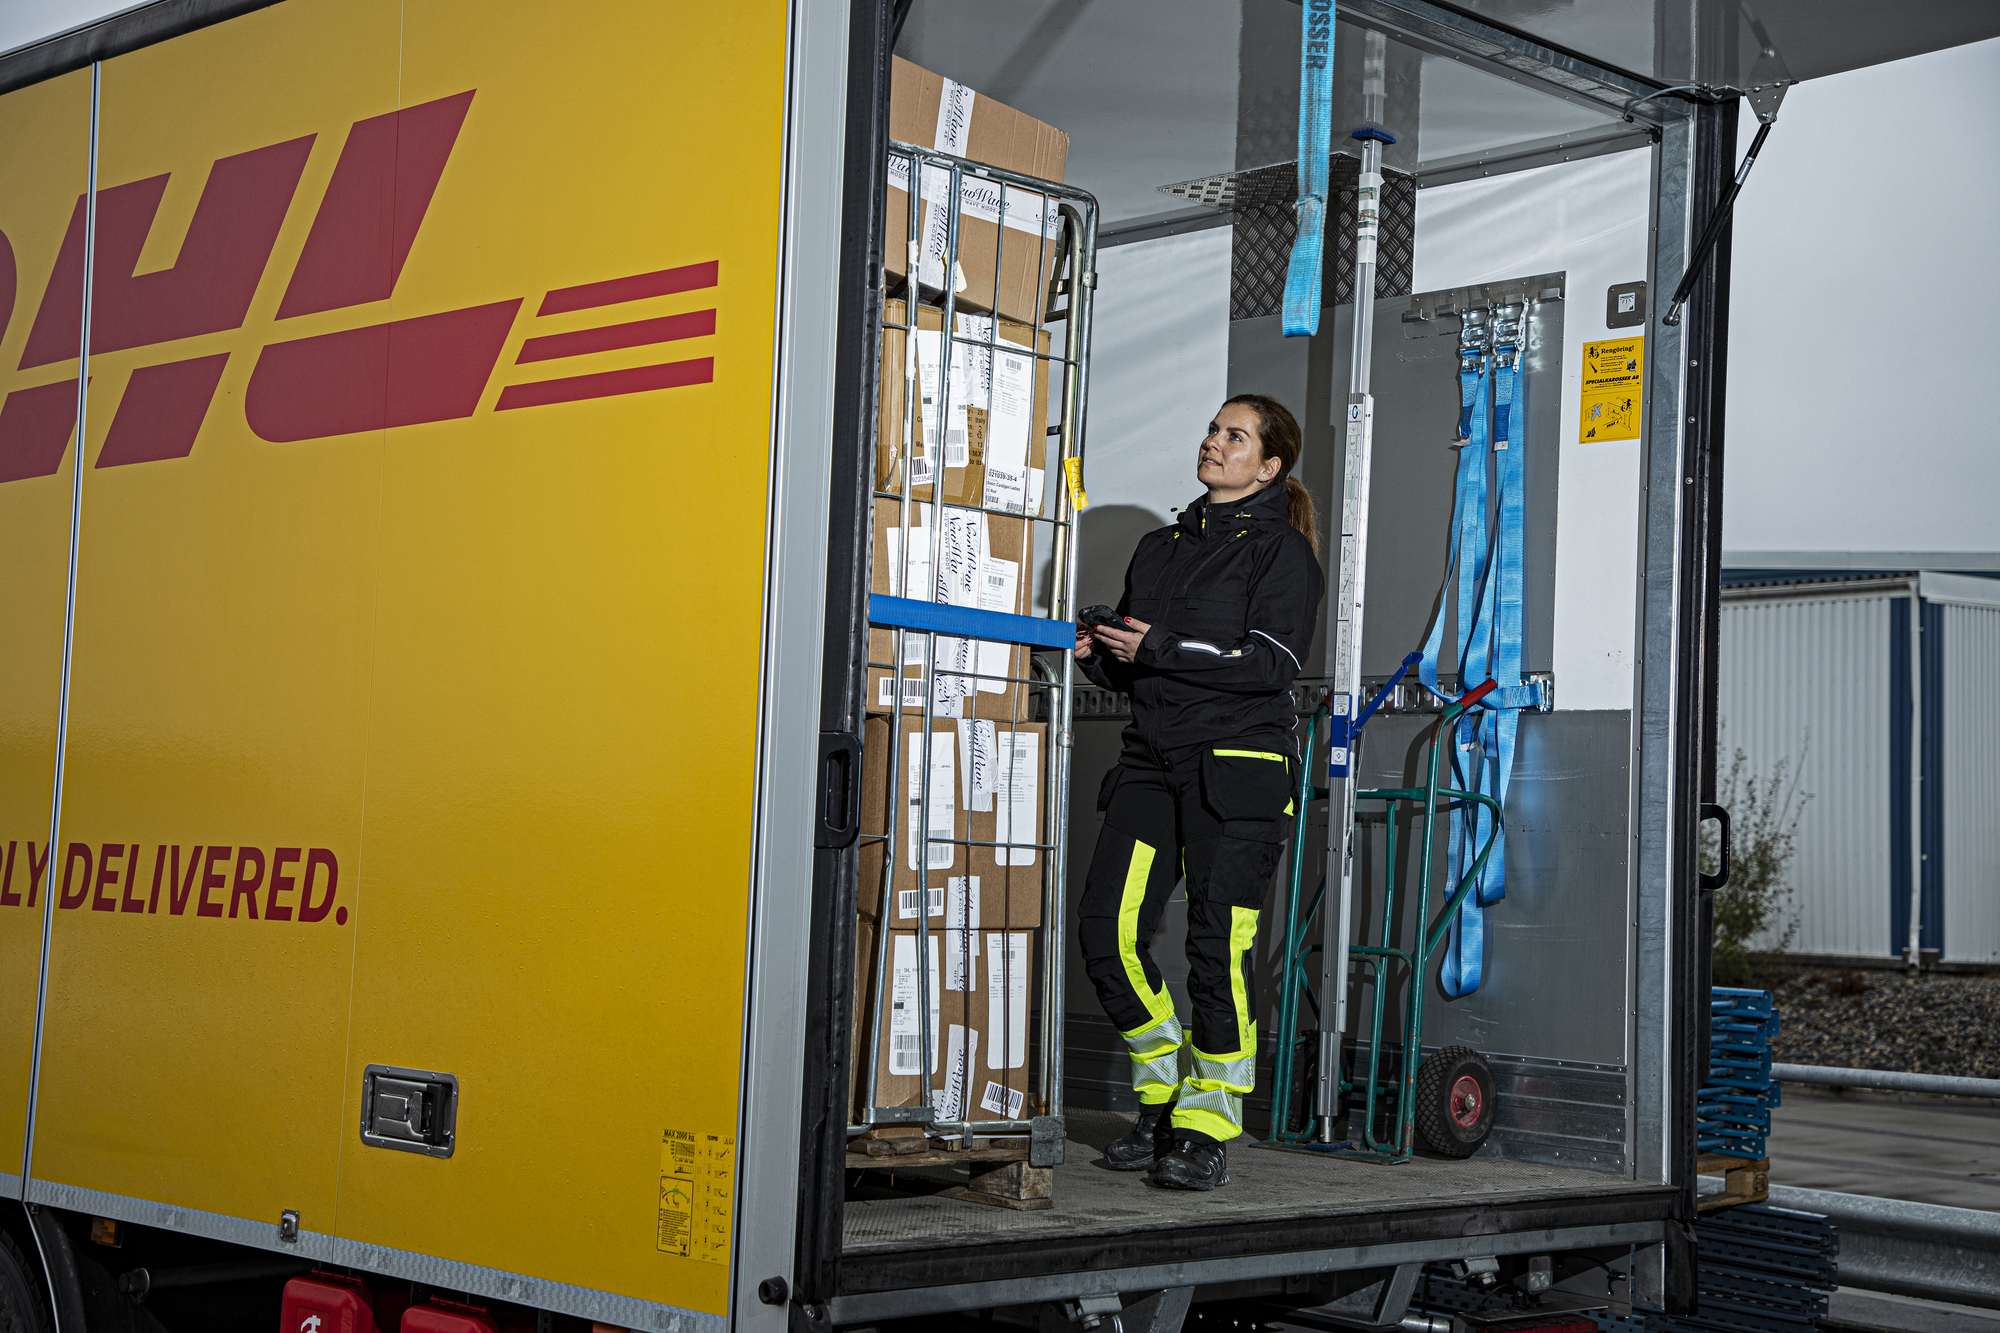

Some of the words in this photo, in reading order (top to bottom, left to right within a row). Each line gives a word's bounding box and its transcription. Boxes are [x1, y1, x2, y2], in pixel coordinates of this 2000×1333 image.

[0, 88, 523, 483] HL
[1600, 345, 1635, 355] Rengöring!
[0, 841, 51, 908] LY
[59, 842, 348, 926] DELIVERED.
[664, 1129, 675, 1138] MAX
[676, 1131, 687, 1140] 2000
[688, 1133, 695, 1142] kg
